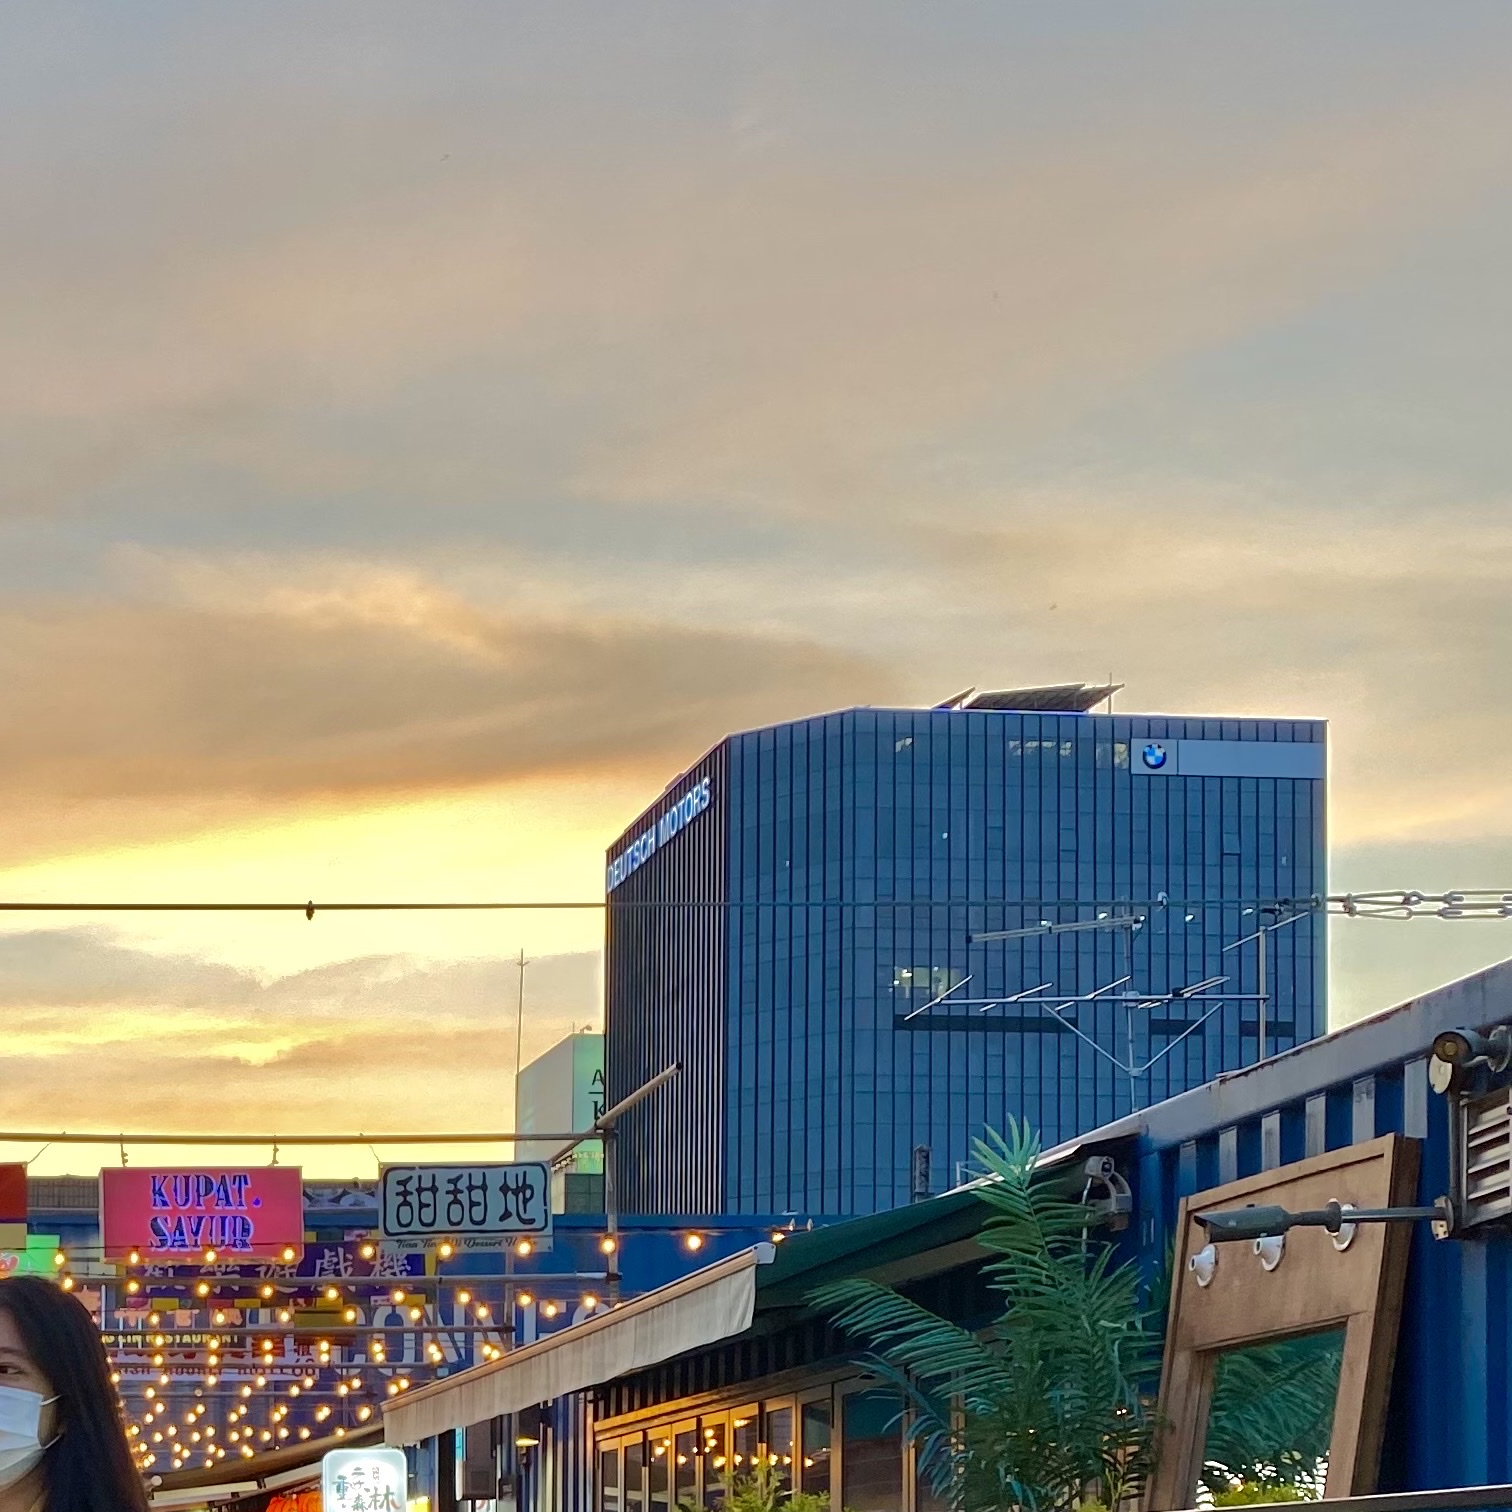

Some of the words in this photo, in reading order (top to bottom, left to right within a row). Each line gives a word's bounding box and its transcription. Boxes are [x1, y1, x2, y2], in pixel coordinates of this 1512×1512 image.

[607, 824, 656, 893] DEUTSCH
[658, 776, 711, 848] MOTORS
[395, 1170, 536, 1228] 甜甜地
